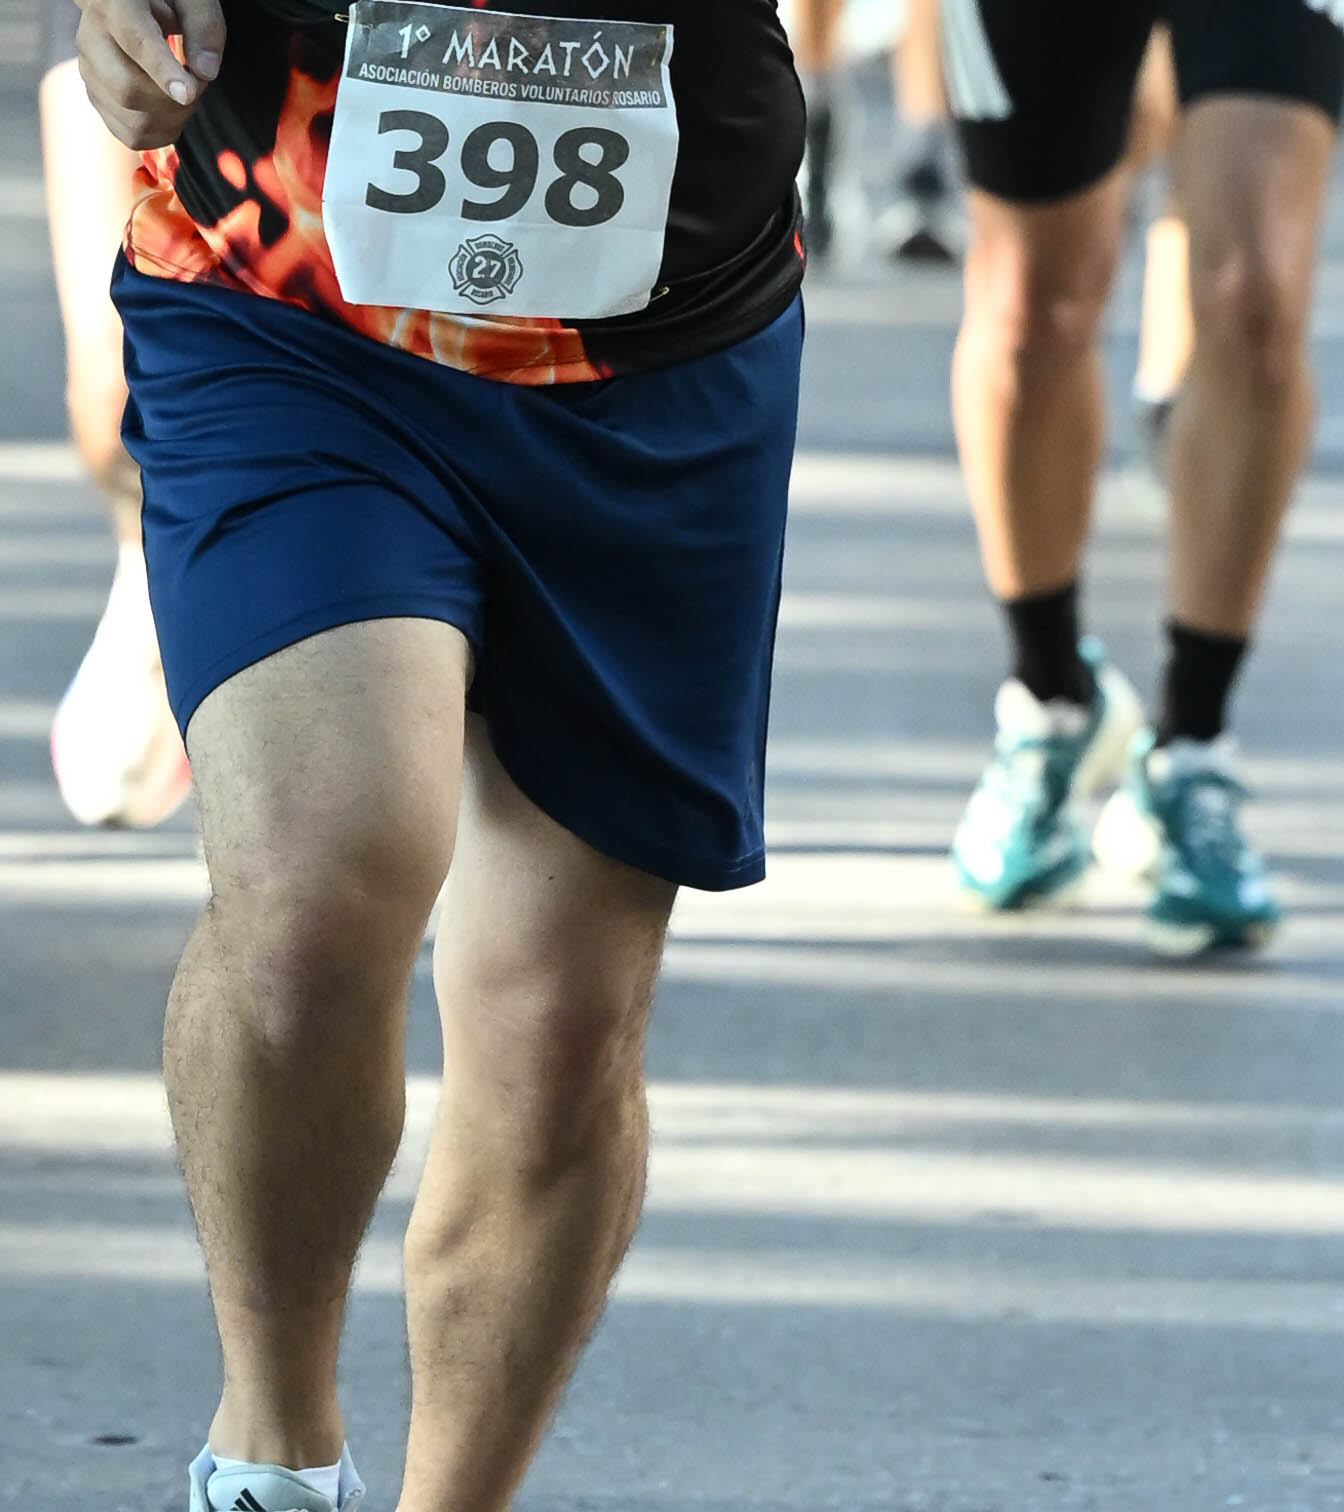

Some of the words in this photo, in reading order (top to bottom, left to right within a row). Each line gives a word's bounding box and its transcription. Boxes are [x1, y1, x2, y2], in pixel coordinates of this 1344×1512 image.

[442, 29, 635, 80] MARATÓN
[359, 63, 439, 88] ASOCIACIÓN
[443, 75, 517, 97] BOMBEROS
[521, 84, 610, 105] VOLUNTARIOS
[612, 90, 661, 106] ROSARIO
[364, 109, 630, 227] 398
[472, 255, 502, 279] 27
